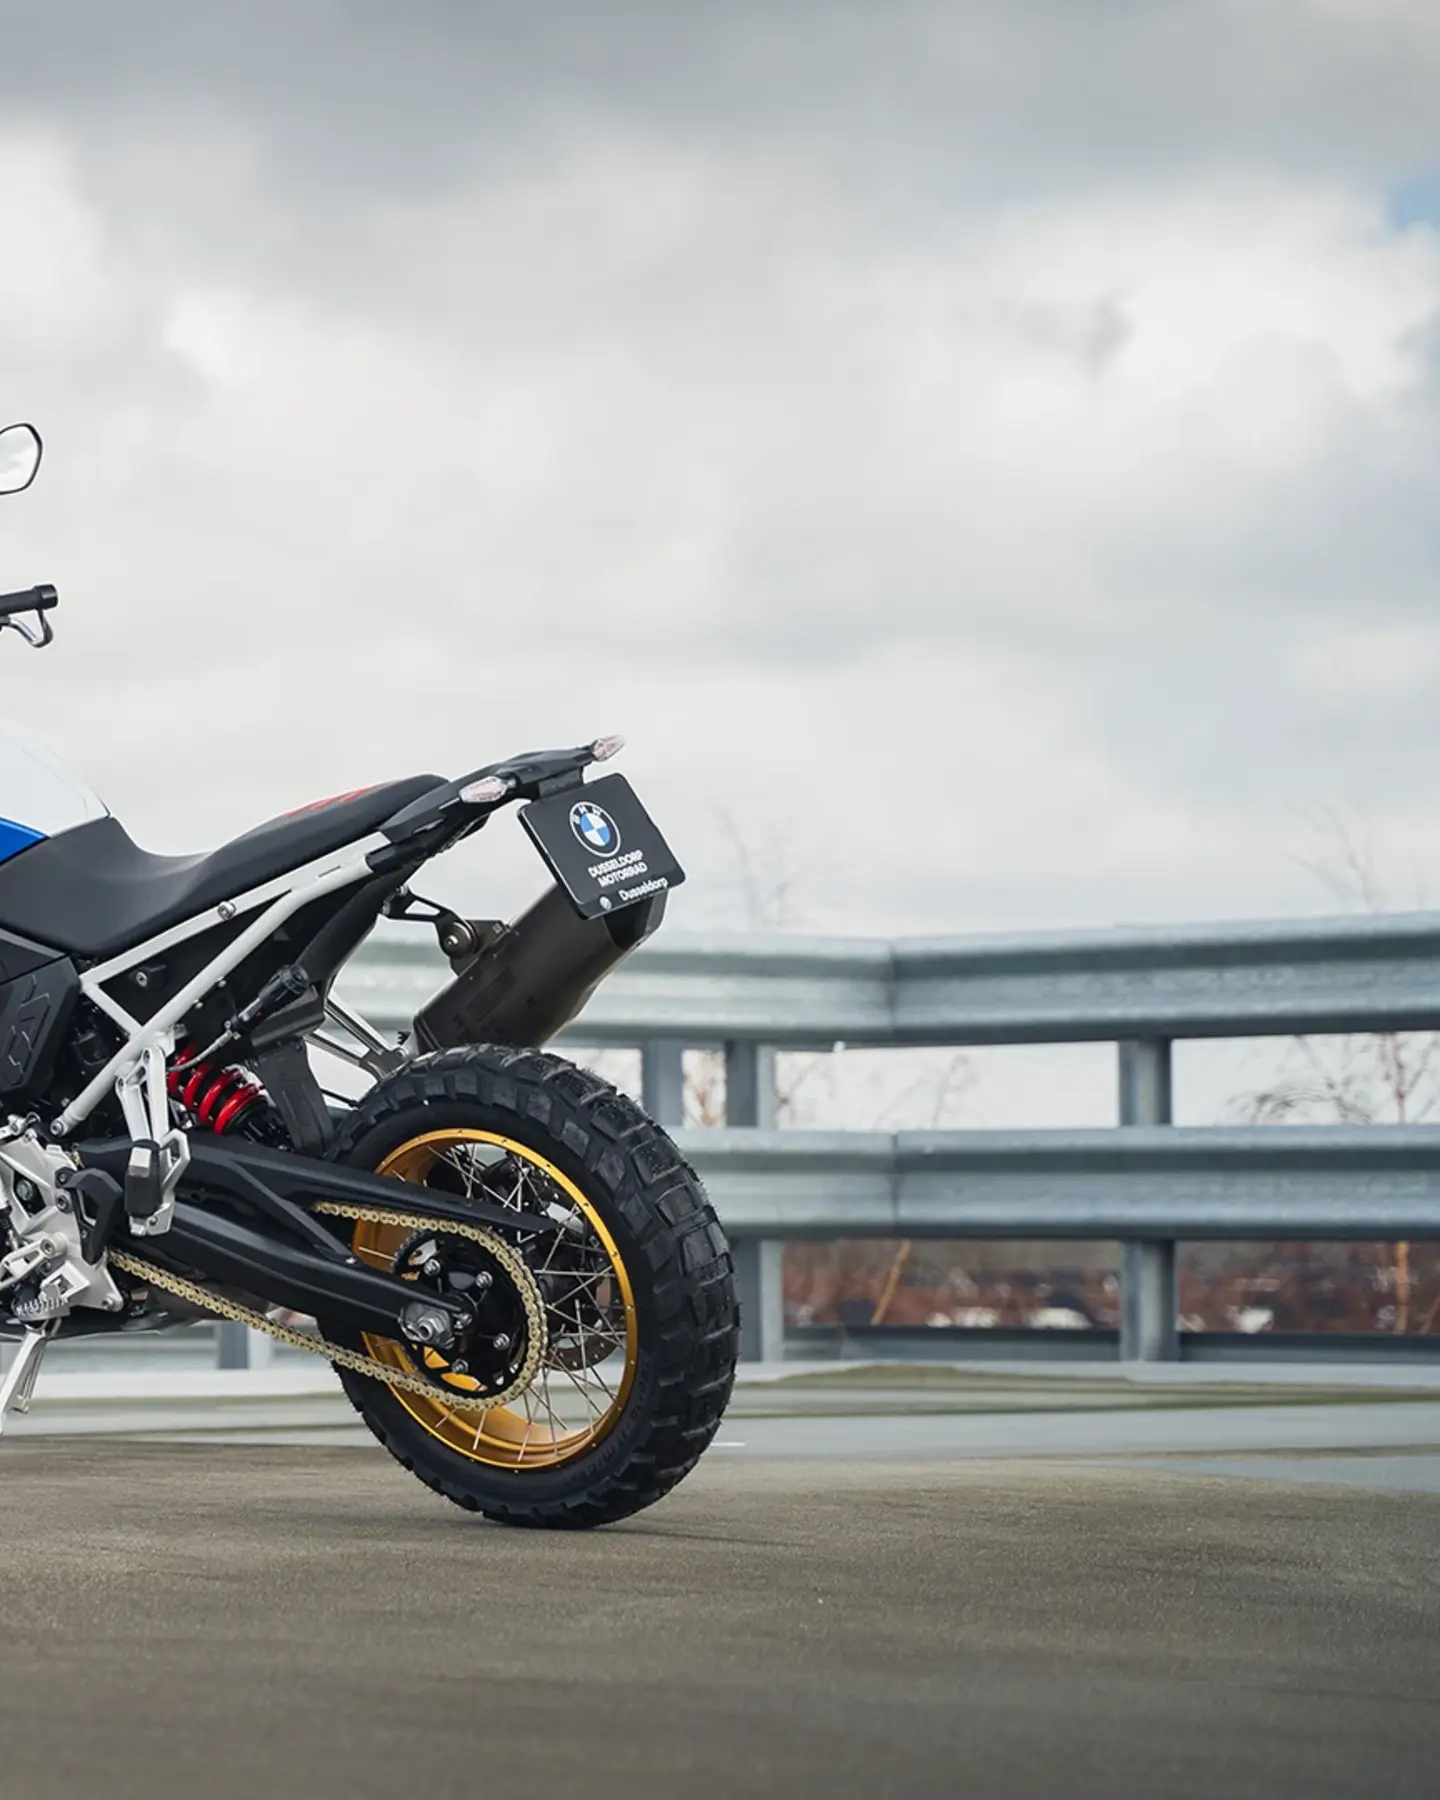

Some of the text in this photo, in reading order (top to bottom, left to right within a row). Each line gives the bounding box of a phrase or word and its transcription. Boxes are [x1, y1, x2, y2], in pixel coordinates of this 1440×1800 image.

[588, 850, 643, 878] DUSSELDORP
[597, 861, 648, 887] MOTORRAD
[618, 877, 668, 901] Dusseldorp
